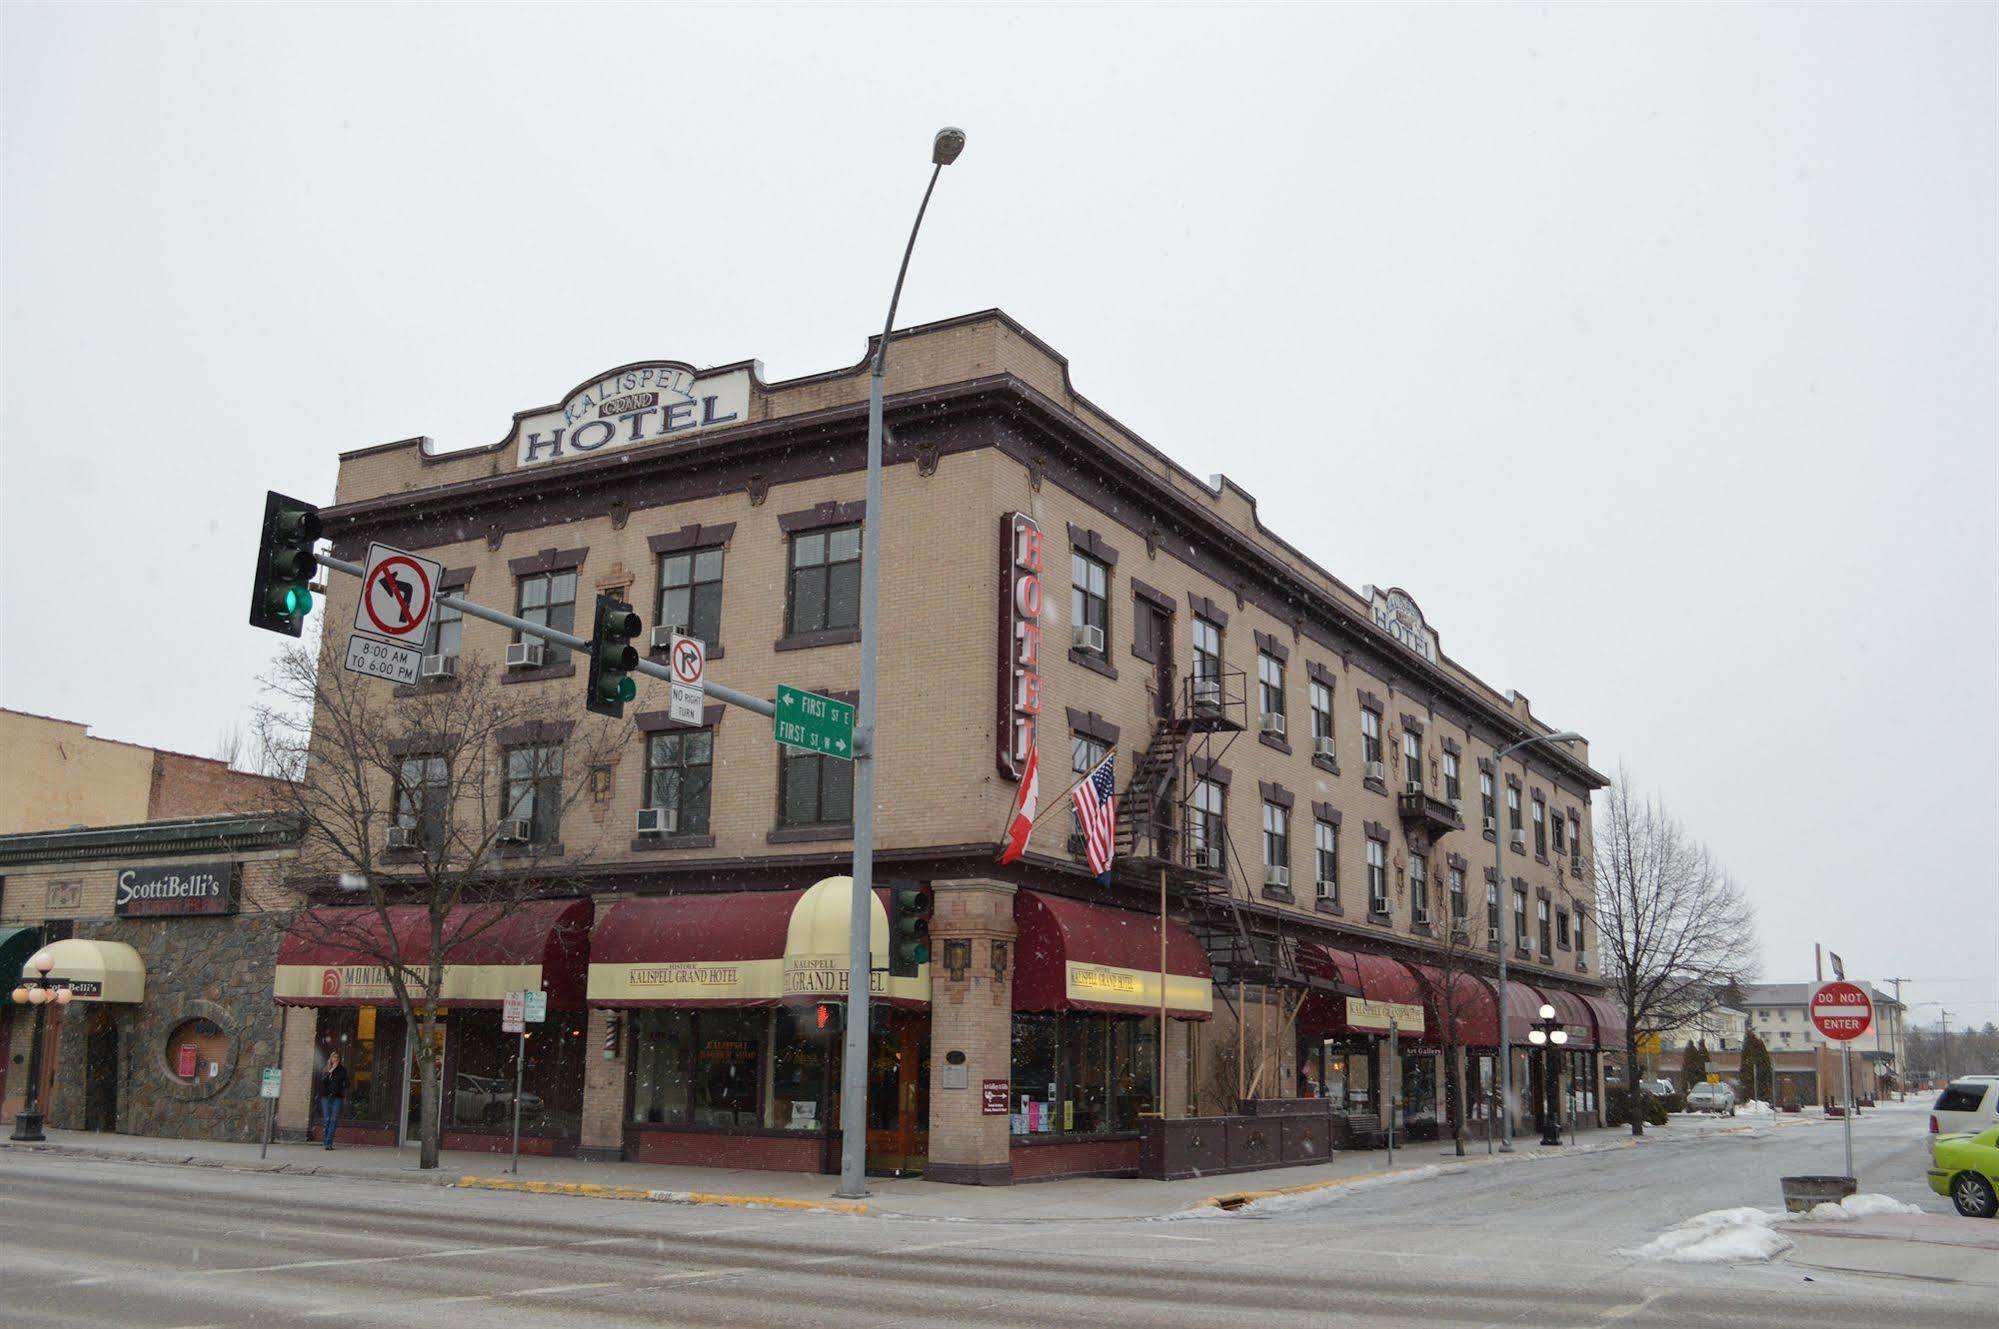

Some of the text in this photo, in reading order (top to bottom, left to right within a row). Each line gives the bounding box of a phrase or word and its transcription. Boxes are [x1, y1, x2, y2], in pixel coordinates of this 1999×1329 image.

[563, 368, 698, 428] KALISPELL
[602, 392, 654, 415] GRAND
[525, 395, 738, 462] HOTEL
[362, 643, 408, 664] 8:00 AM
[352, 654, 365, 668] TO
[398, 666, 413, 680] PM
[672, 688, 702, 705] NO RIGHT
[678, 706, 695, 720] TURN
[801, 696, 849, 725] FIRST ST E
[779, 721, 806, 743] FIRST
[810, 732, 818, 747] ST
[117, 870, 220, 905] ScottiBelli's
[793, 959, 834, 969] KALISPELL
[629, 969, 738, 984] KALISPELL GRAND HOTEL
[792, 971, 835, 991] GRAND
[839, 971, 885, 992] HEL
[1818, 993, 1864, 1004] DO NOT
[1823, 1019, 1860, 1030] ENTER
